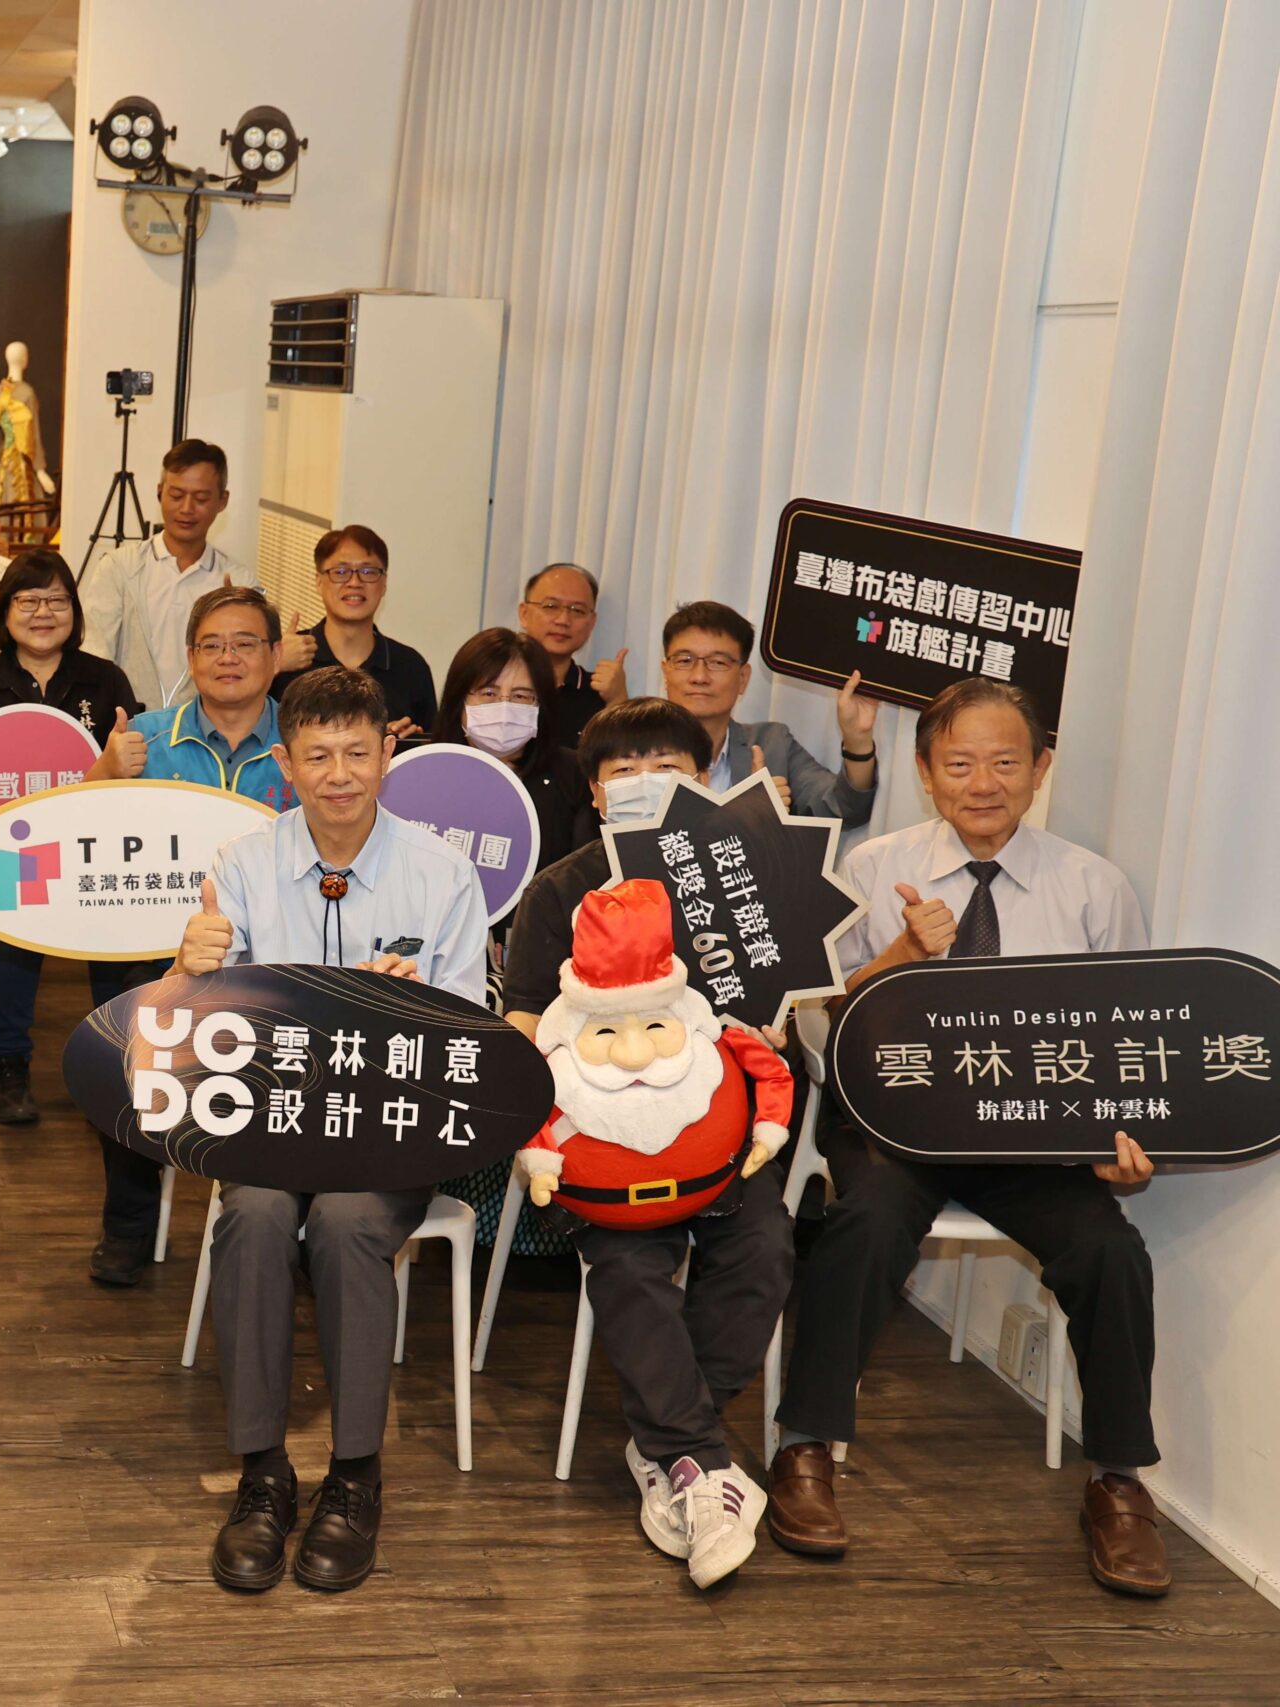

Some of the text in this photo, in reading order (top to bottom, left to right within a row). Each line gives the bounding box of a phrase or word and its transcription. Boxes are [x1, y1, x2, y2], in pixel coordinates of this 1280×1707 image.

[794, 550, 1070, 647] 臺灣布袋戲傳習中心
[885, 616, 1015, 682] 旗艦計畫
[78, 699, 96, 735] 雲林
[78, 871, 206, 893] 臺灣布袋戲傳
[79, 898, 124, 907] TAIWAN
[130, 897, 171, 906] POTEHI
[708, 835, 781, 968] 設計競賽
[657, 829, 745, 1006] 總獎金60萬
[926, 1004, 1191, 1028] Yunlin Design Award
[272, 1025, 482, 1084] 雲林創意
[875, 1034, 1272, 1087] 雲林設計獎
[267, 1088, 476, 1146] 設計中心
